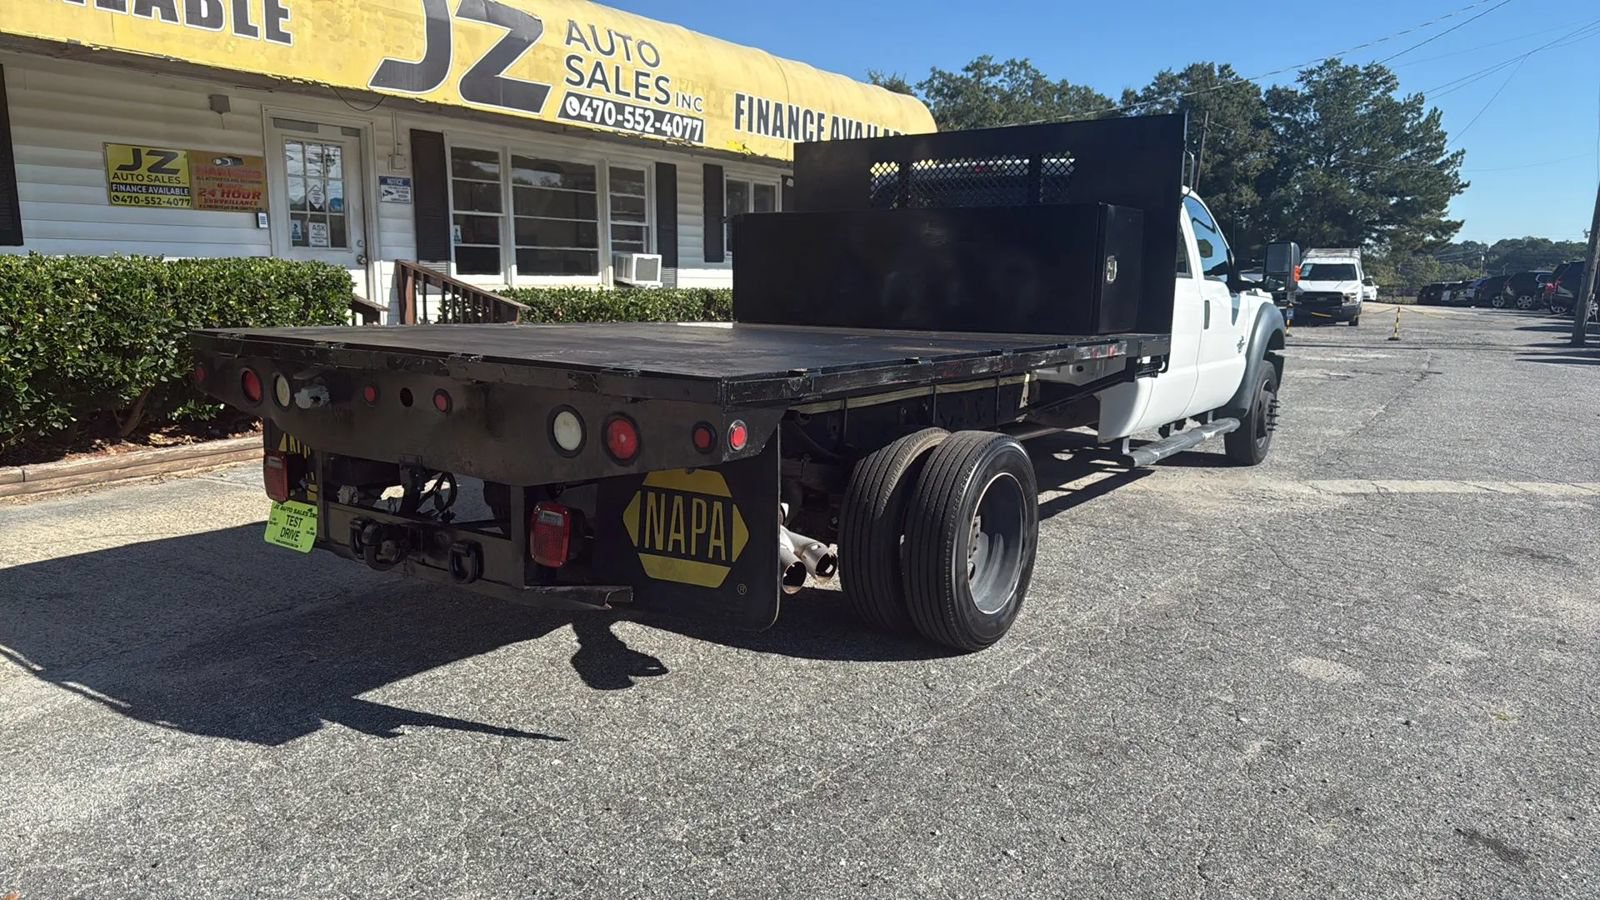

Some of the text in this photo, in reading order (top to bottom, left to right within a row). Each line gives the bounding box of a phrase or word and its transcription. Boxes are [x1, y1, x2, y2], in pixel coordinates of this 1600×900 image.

[367, 0, 553, 114] JZ
[565, 19, 660, 68] AUTO
[565, 54, 703, 112] SALES INC
[580, 98, 702, 142] 470-552-4077
[734, 92, 826, 142] FINANCE
[116, 148, 181, 175] JZ
[112, 172, 181, 185] AUTO SALES
[112, 184, 190, 195] FINANCE AVAILABLE
[121, 195, 192, 206] 470-552-4077
[199, 188, 262, 200] 24 HOUR
[280, 527, 301, 542] DRIVE
[286, 514, 304, 529] TEST
[644, 491, 726, 561] NAPA
